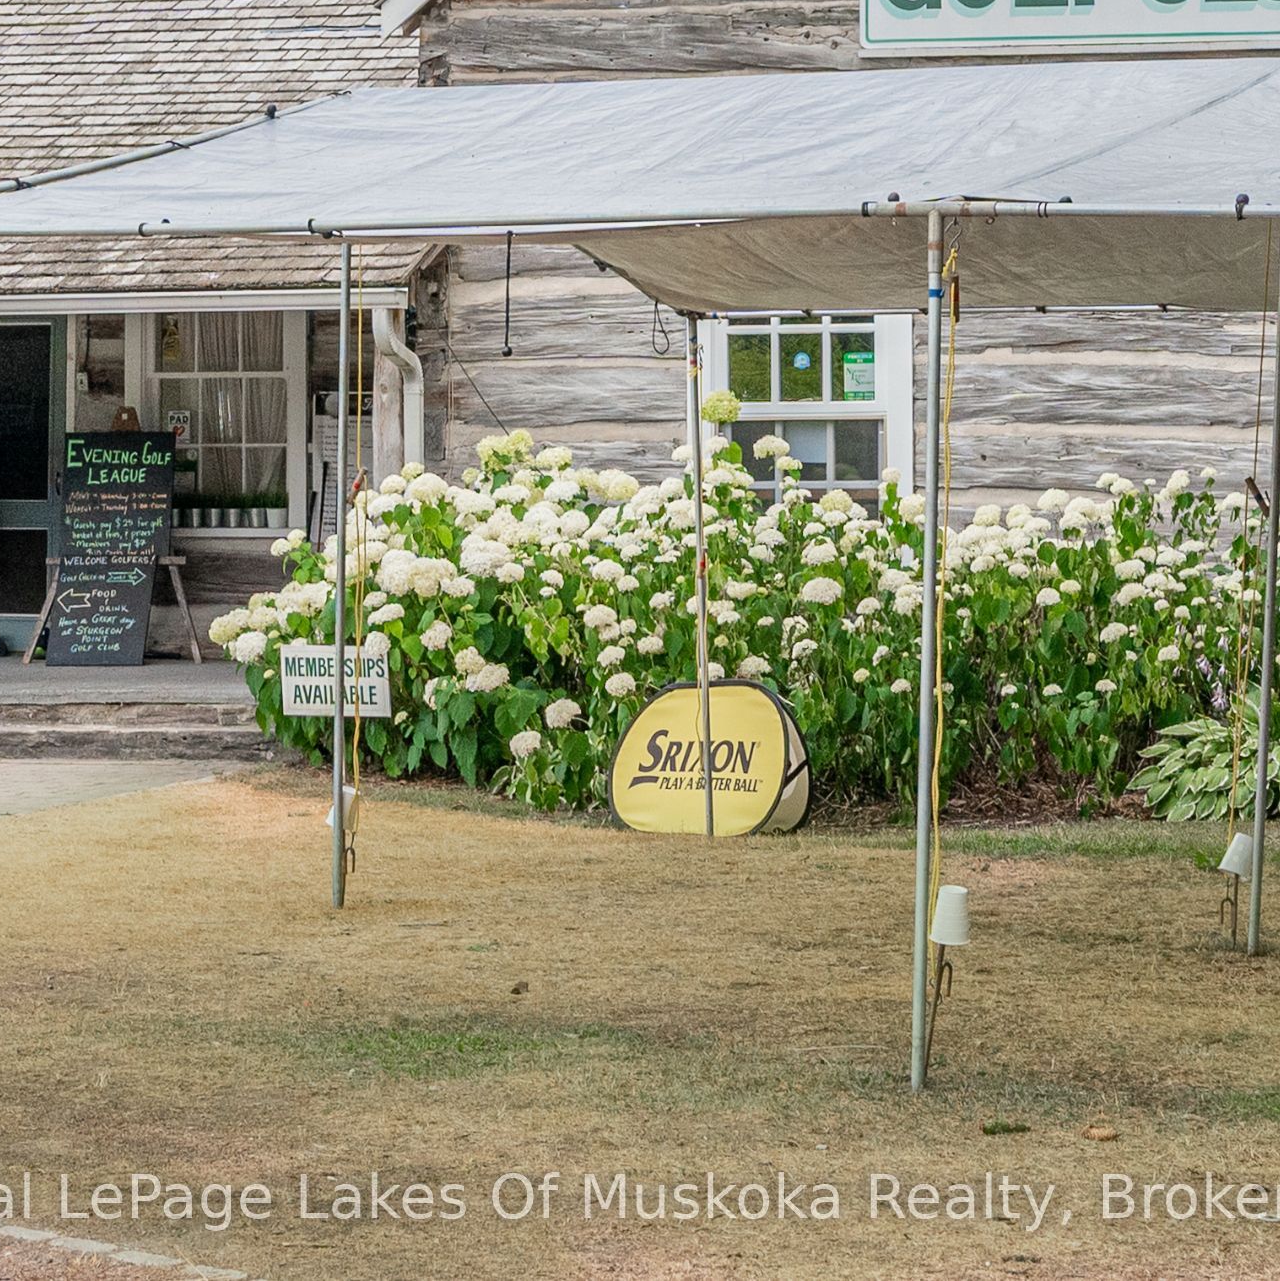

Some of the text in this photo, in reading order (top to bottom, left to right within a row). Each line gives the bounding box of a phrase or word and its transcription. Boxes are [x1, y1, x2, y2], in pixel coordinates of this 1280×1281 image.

[87, 467, 147, 485] LEAGUE
[63, 556, 108, 566] WELCOME
[91, 589, 117, 598] FOOD
[99, 605, 129, 613] DRINK
[76, 625, 123, 636] STURGEON
[285, 656, 385, 678] MEMBESIPS
[638, 729, 756, 774] SRIXON
[659, 777, 758, 792] PLAY A BTER BALL
